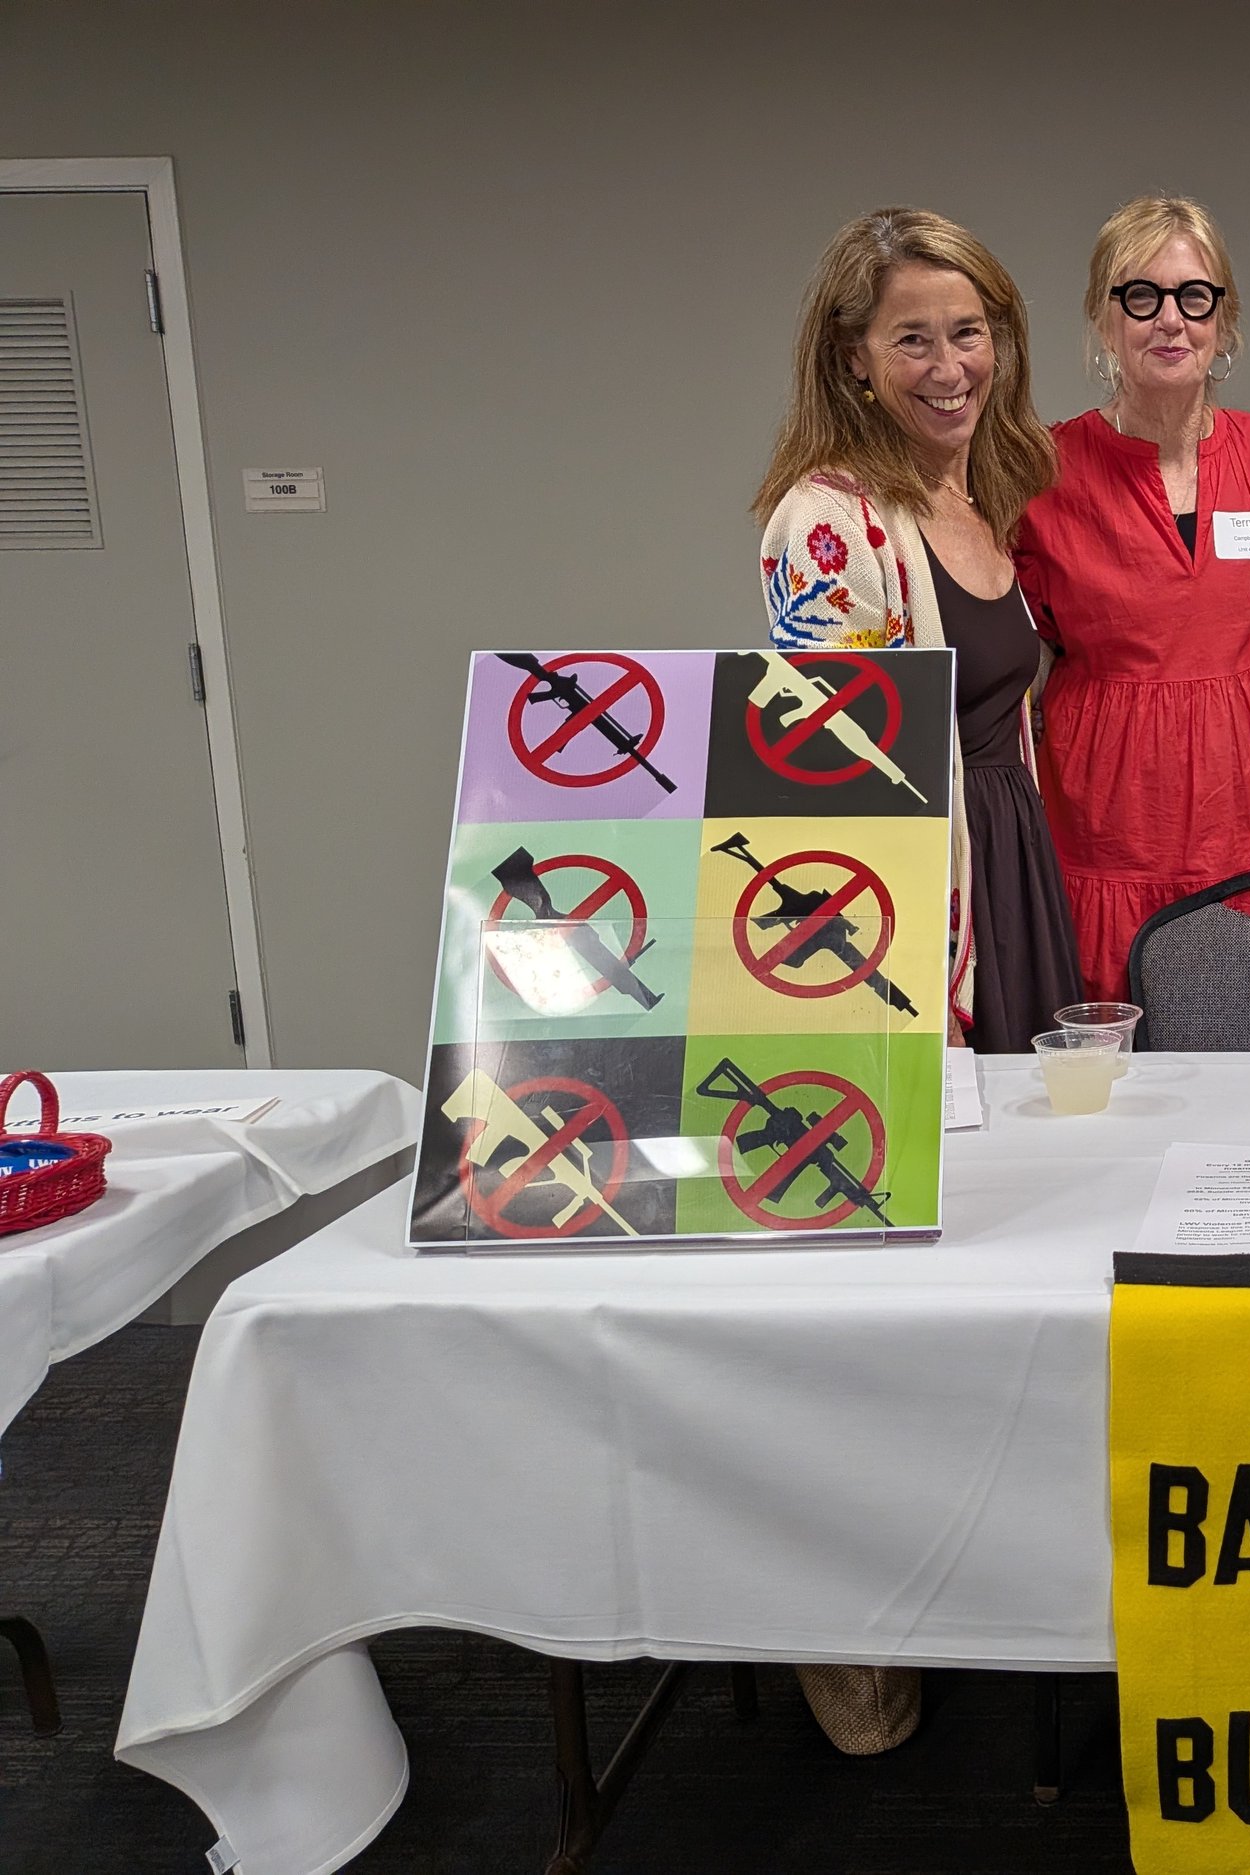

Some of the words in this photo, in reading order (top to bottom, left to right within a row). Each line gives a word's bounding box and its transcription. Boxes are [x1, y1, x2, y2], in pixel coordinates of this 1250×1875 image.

[261, 471, 285, 479] Storage
[269, 484, 297, 495] 100B
[111, 1112, 146, 1120] to
[157, 1105, 239, 1117] wear
